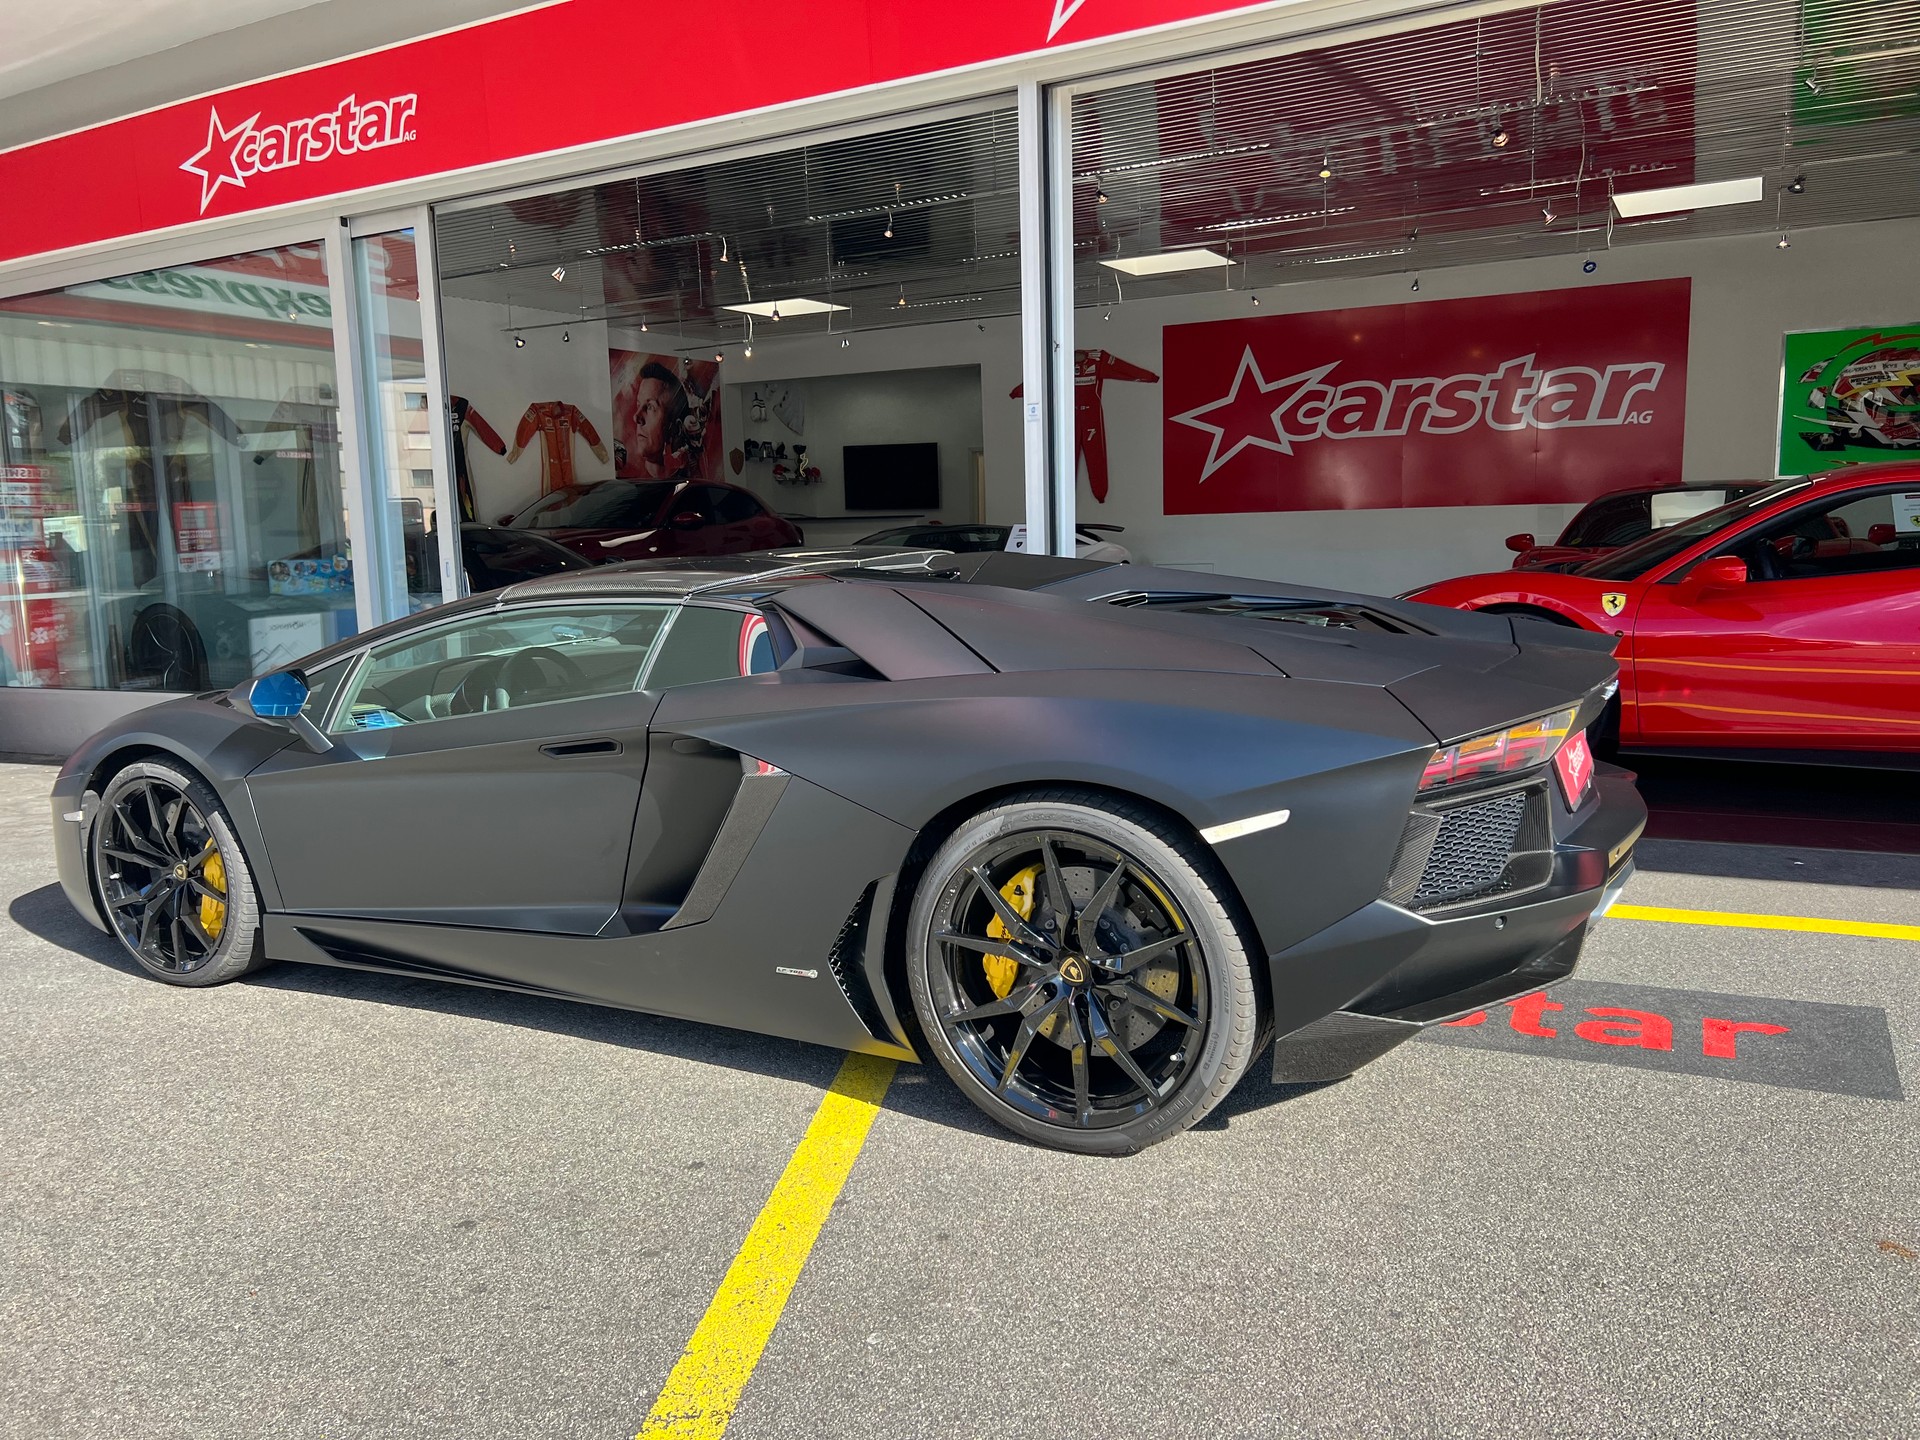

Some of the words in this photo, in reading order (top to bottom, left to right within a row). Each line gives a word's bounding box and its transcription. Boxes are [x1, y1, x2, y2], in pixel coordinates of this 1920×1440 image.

[231, 93, 417, 176] carstar
[403, 129, 417, 142] AG
[1273, 352, 1665, 442] carstar
[1624, 410, 1654, 425] AG
[1086, 428, 1097, 442] 7
[1439, 991, 1791, 1059] tar
